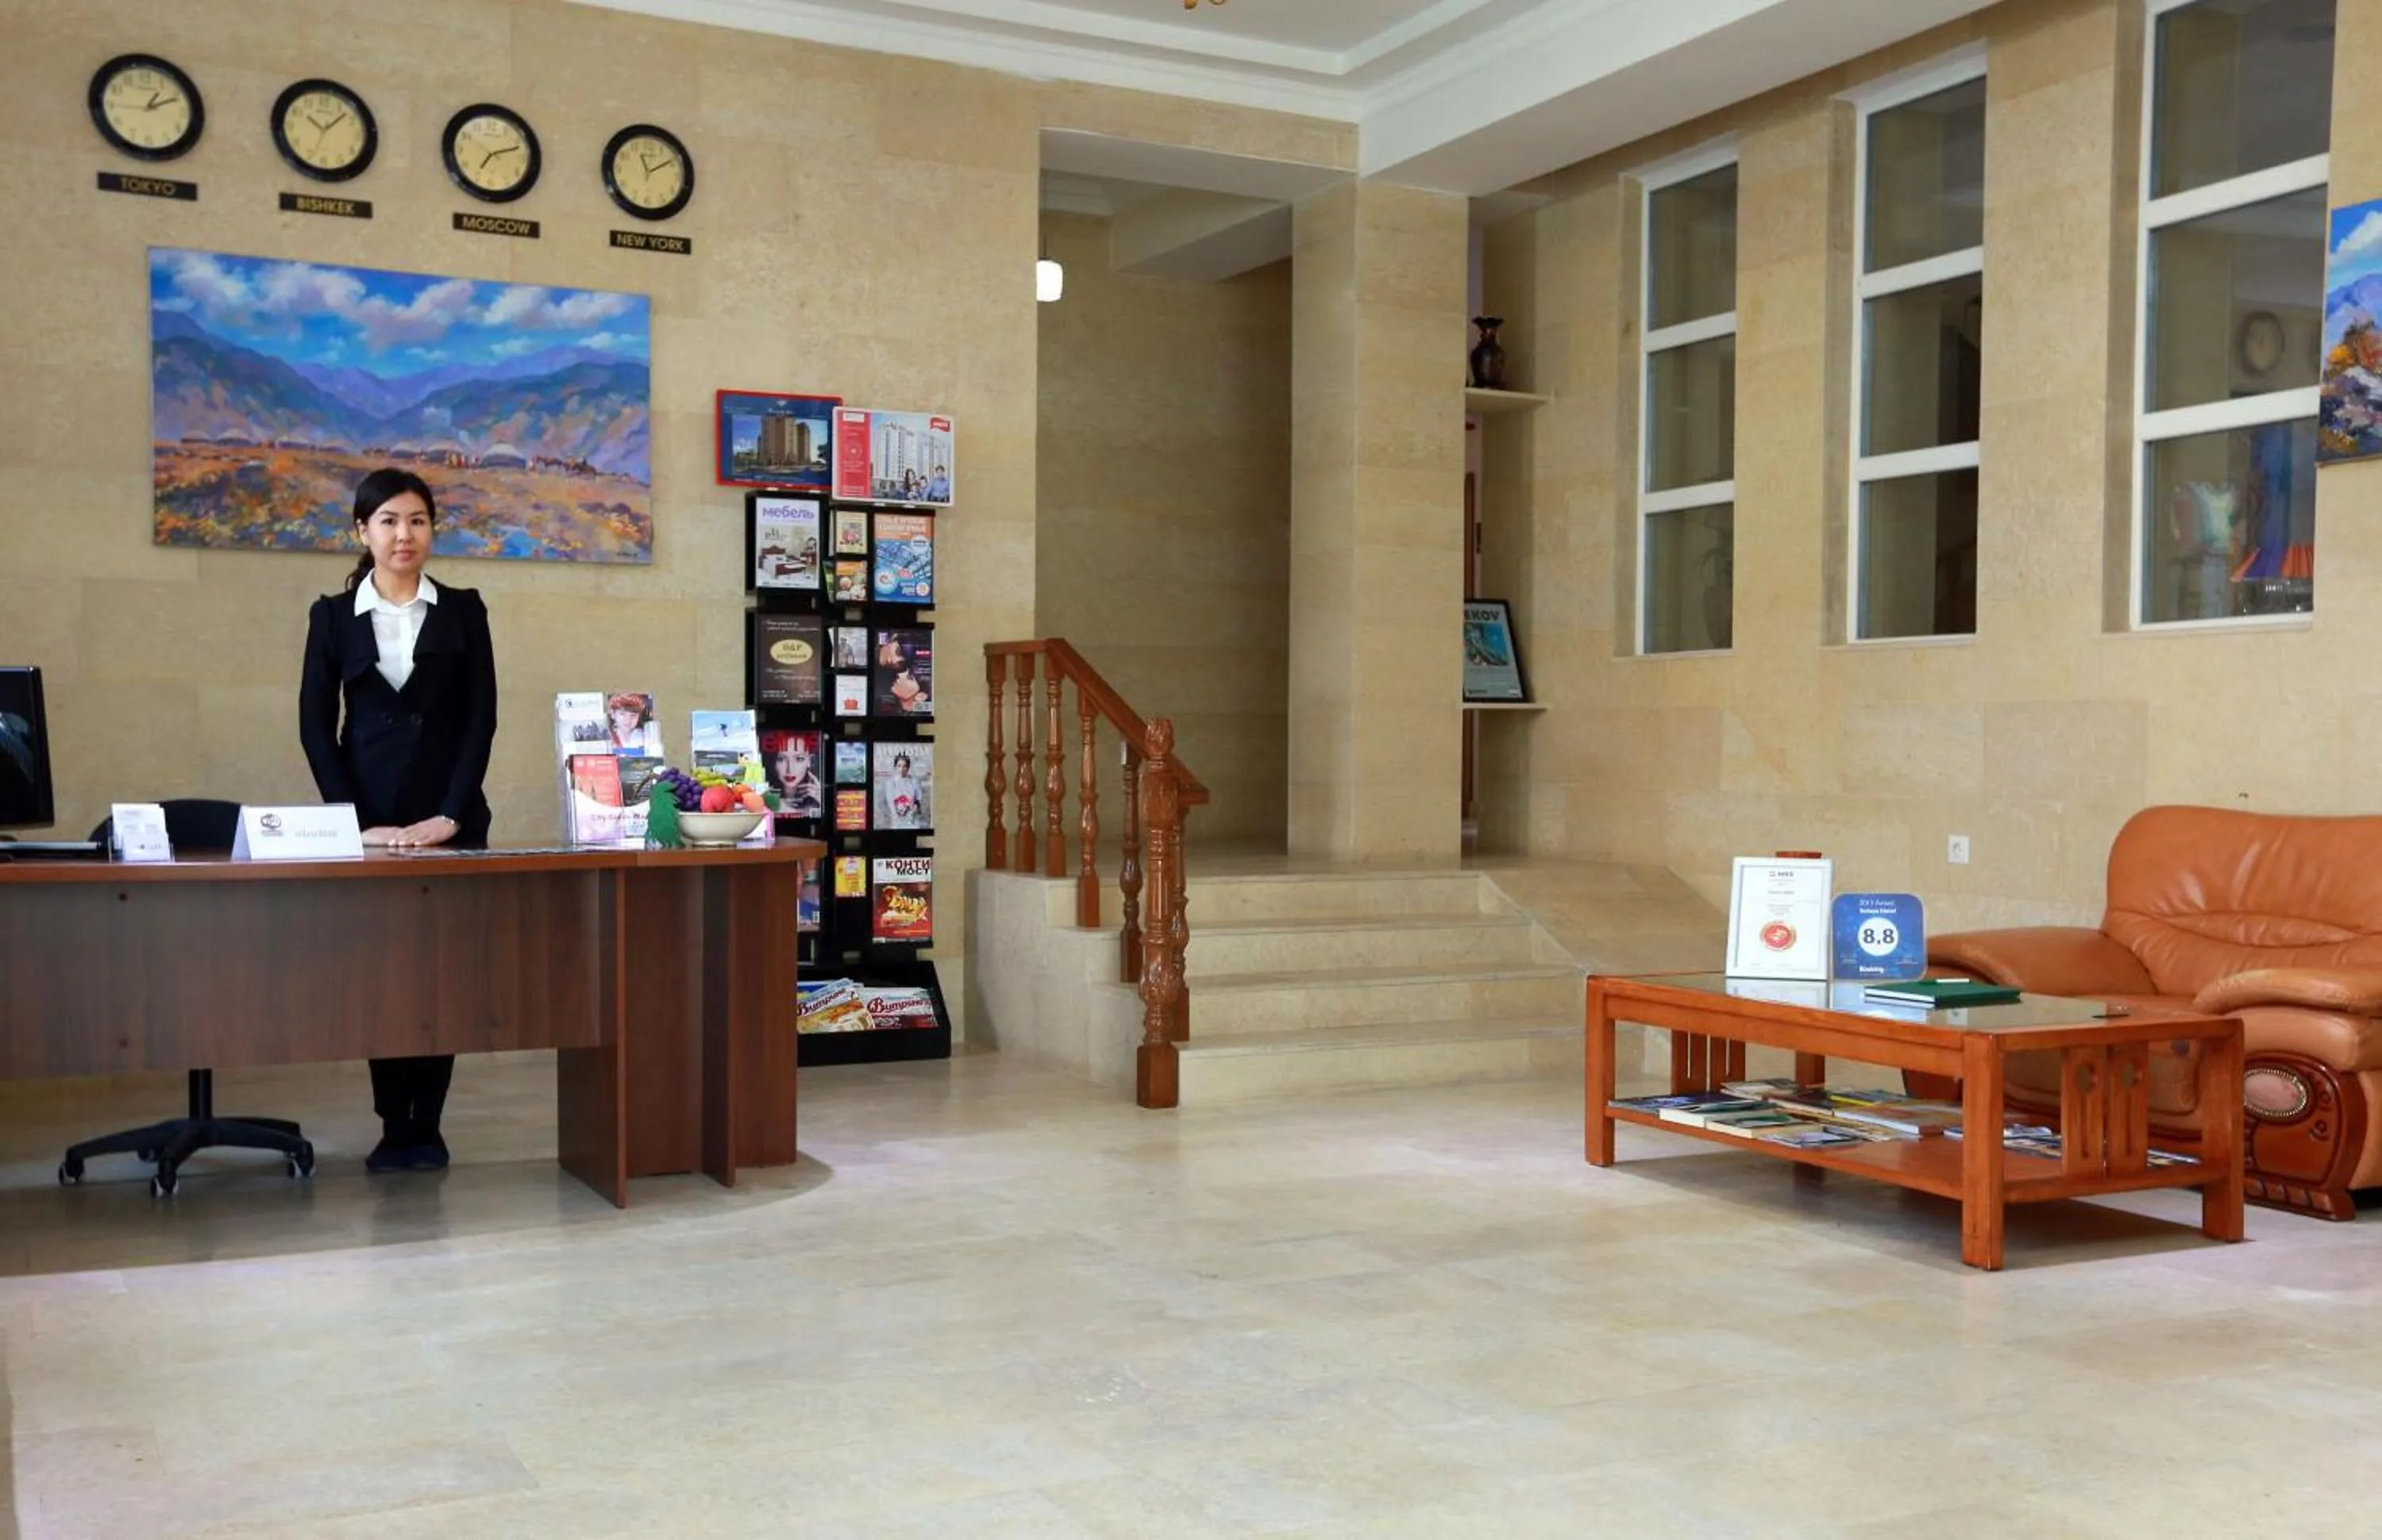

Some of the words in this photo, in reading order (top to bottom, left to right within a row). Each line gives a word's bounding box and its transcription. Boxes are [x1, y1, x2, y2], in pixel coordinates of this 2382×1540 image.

[120, 177, 175, 196] TOKYO
[297, 196, 355, 216] BISHKEK
[462, 216, 530, 235] MOSCOW
[615, 233, 646, 248] NEW
[649, 237, 684, 252] YORK
[885, 860, 931, 870] КОНТИ
[1863, 927, 1895, 945] 8.8
